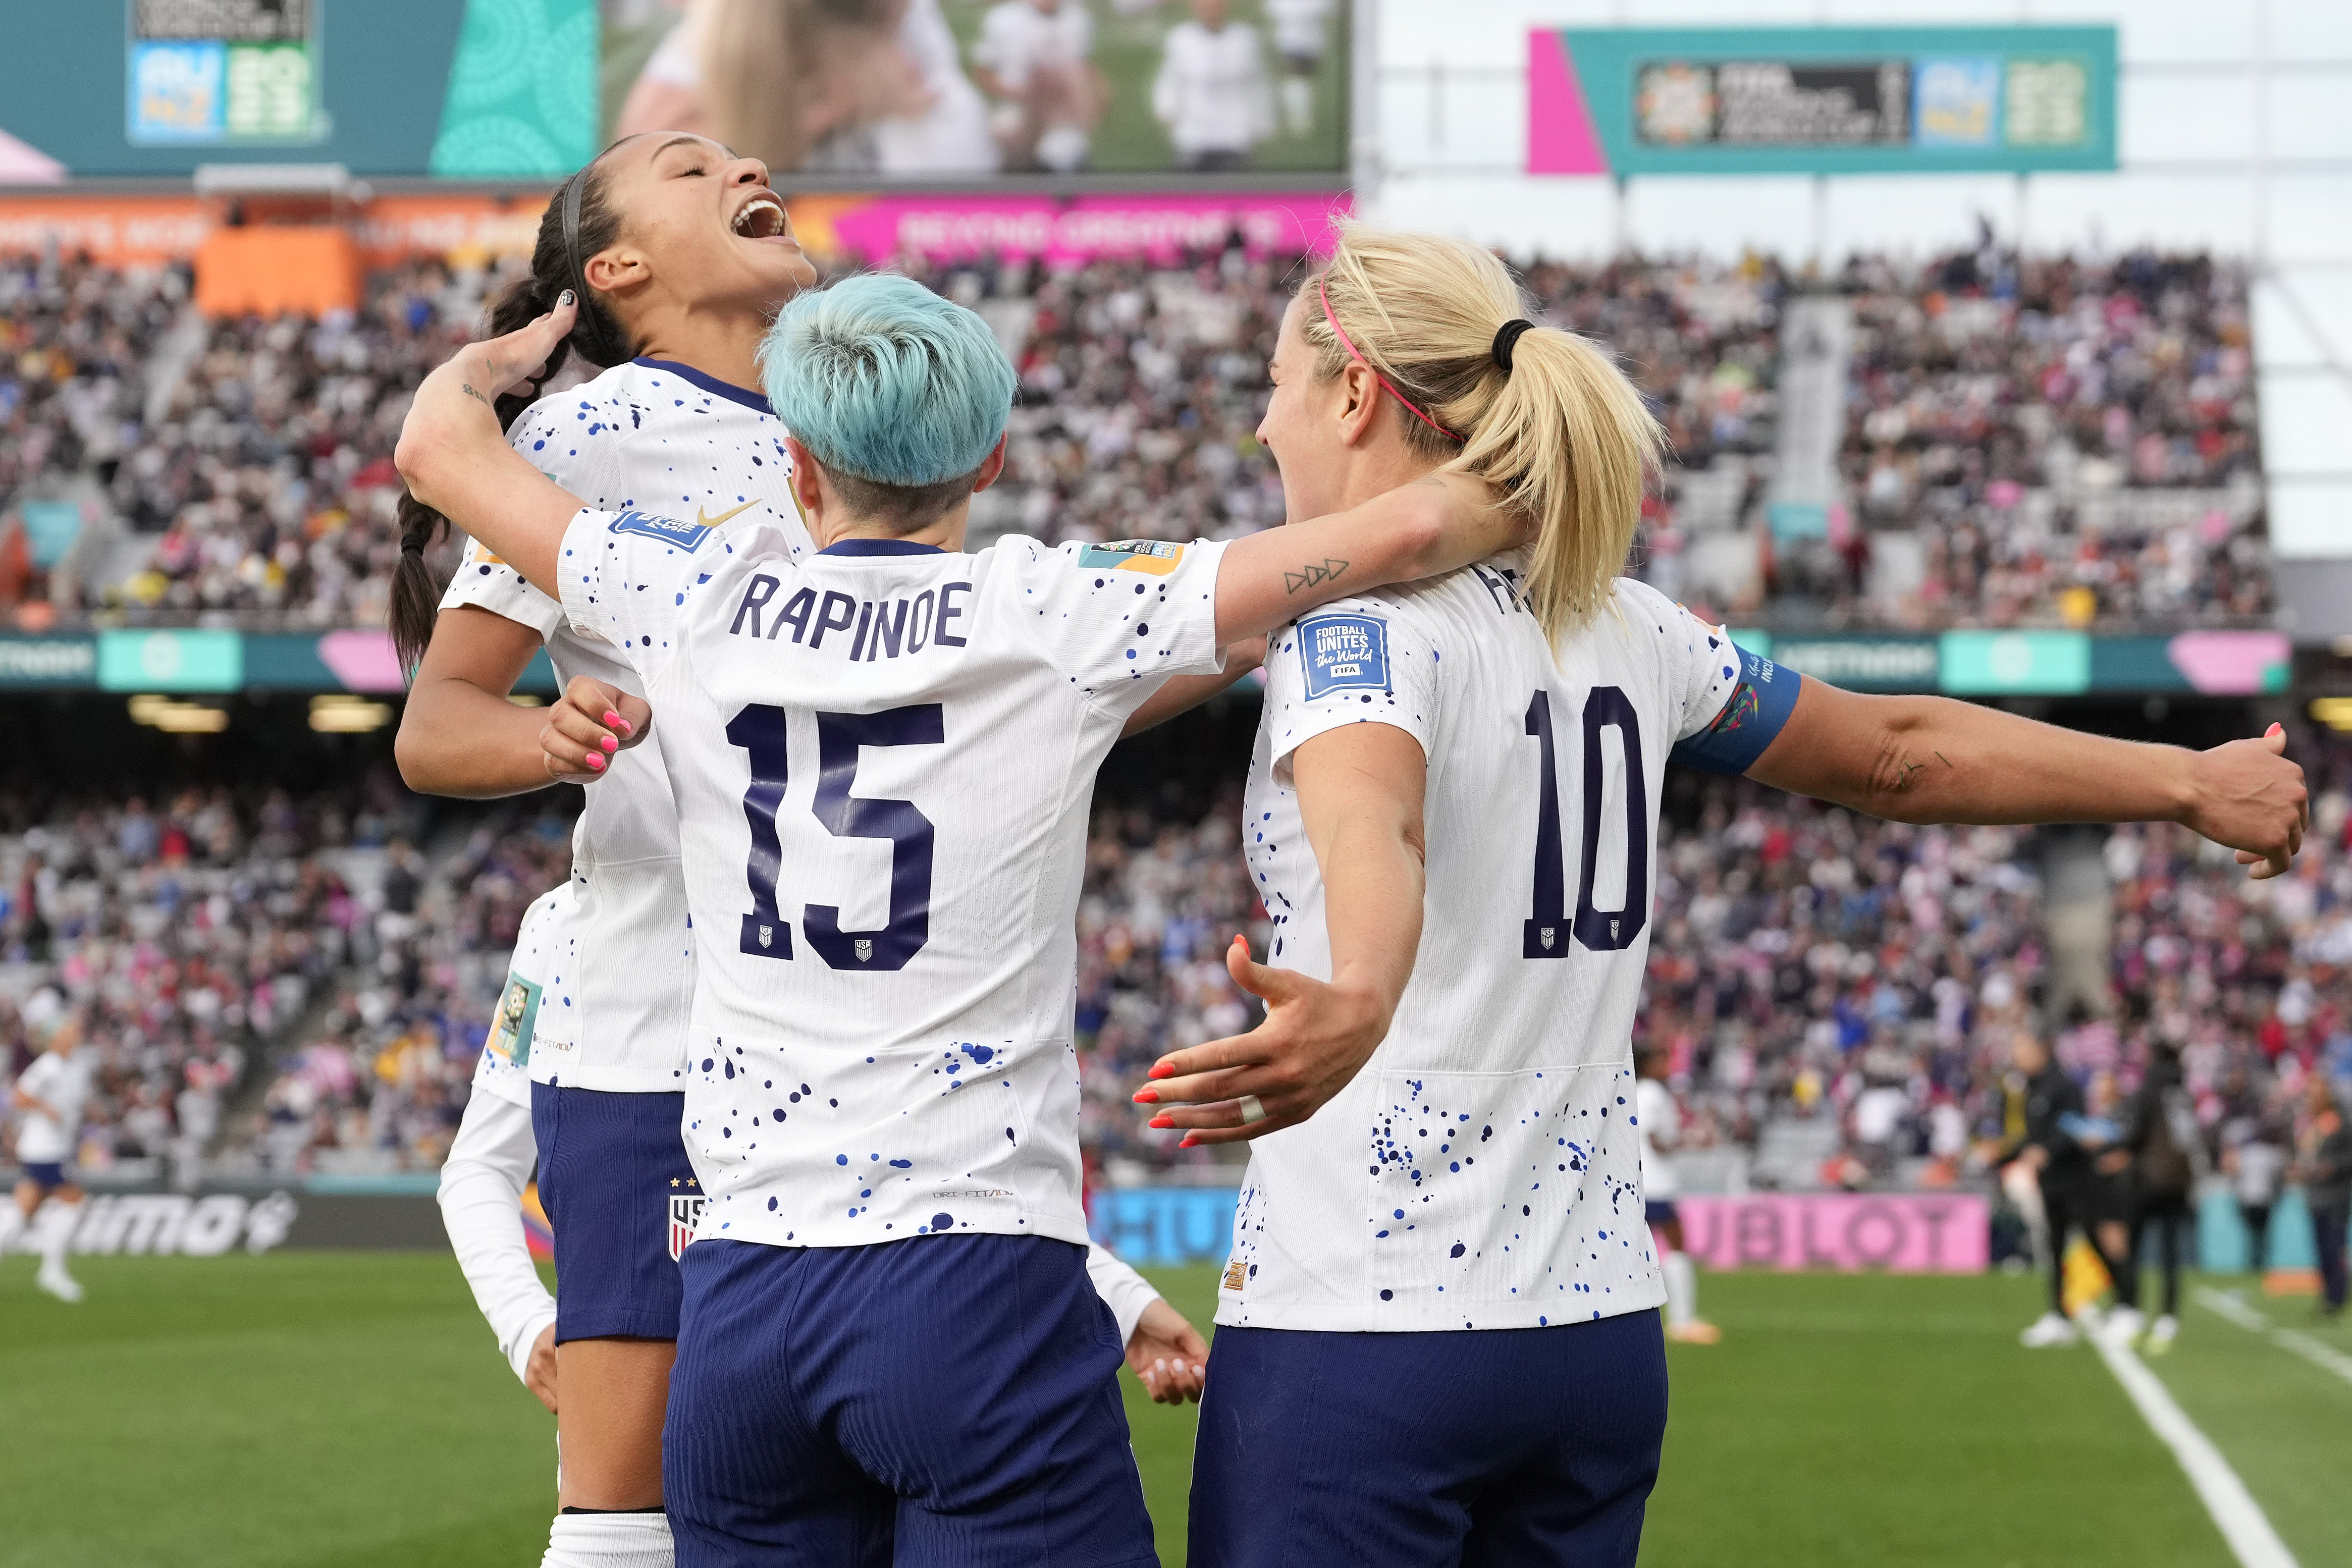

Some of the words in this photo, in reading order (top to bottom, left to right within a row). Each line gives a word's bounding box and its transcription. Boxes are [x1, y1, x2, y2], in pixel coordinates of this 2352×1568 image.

[729, 573, 972, 662] RAPINOE
[1316, 625, 1367, 639] FOOTBALL
[1317, 635, 1368, 653] UNITES
[1315, 653, 1335, 668] the
[1337, 647, 1373, 663] World
[1523, 686, 1647, 959] 10
[725, 702, 944, 971] 15
[761, 927, 771, 935] USA
[1542, 929, 1555, 937] USA
[856, 941, 871, 949] USA
